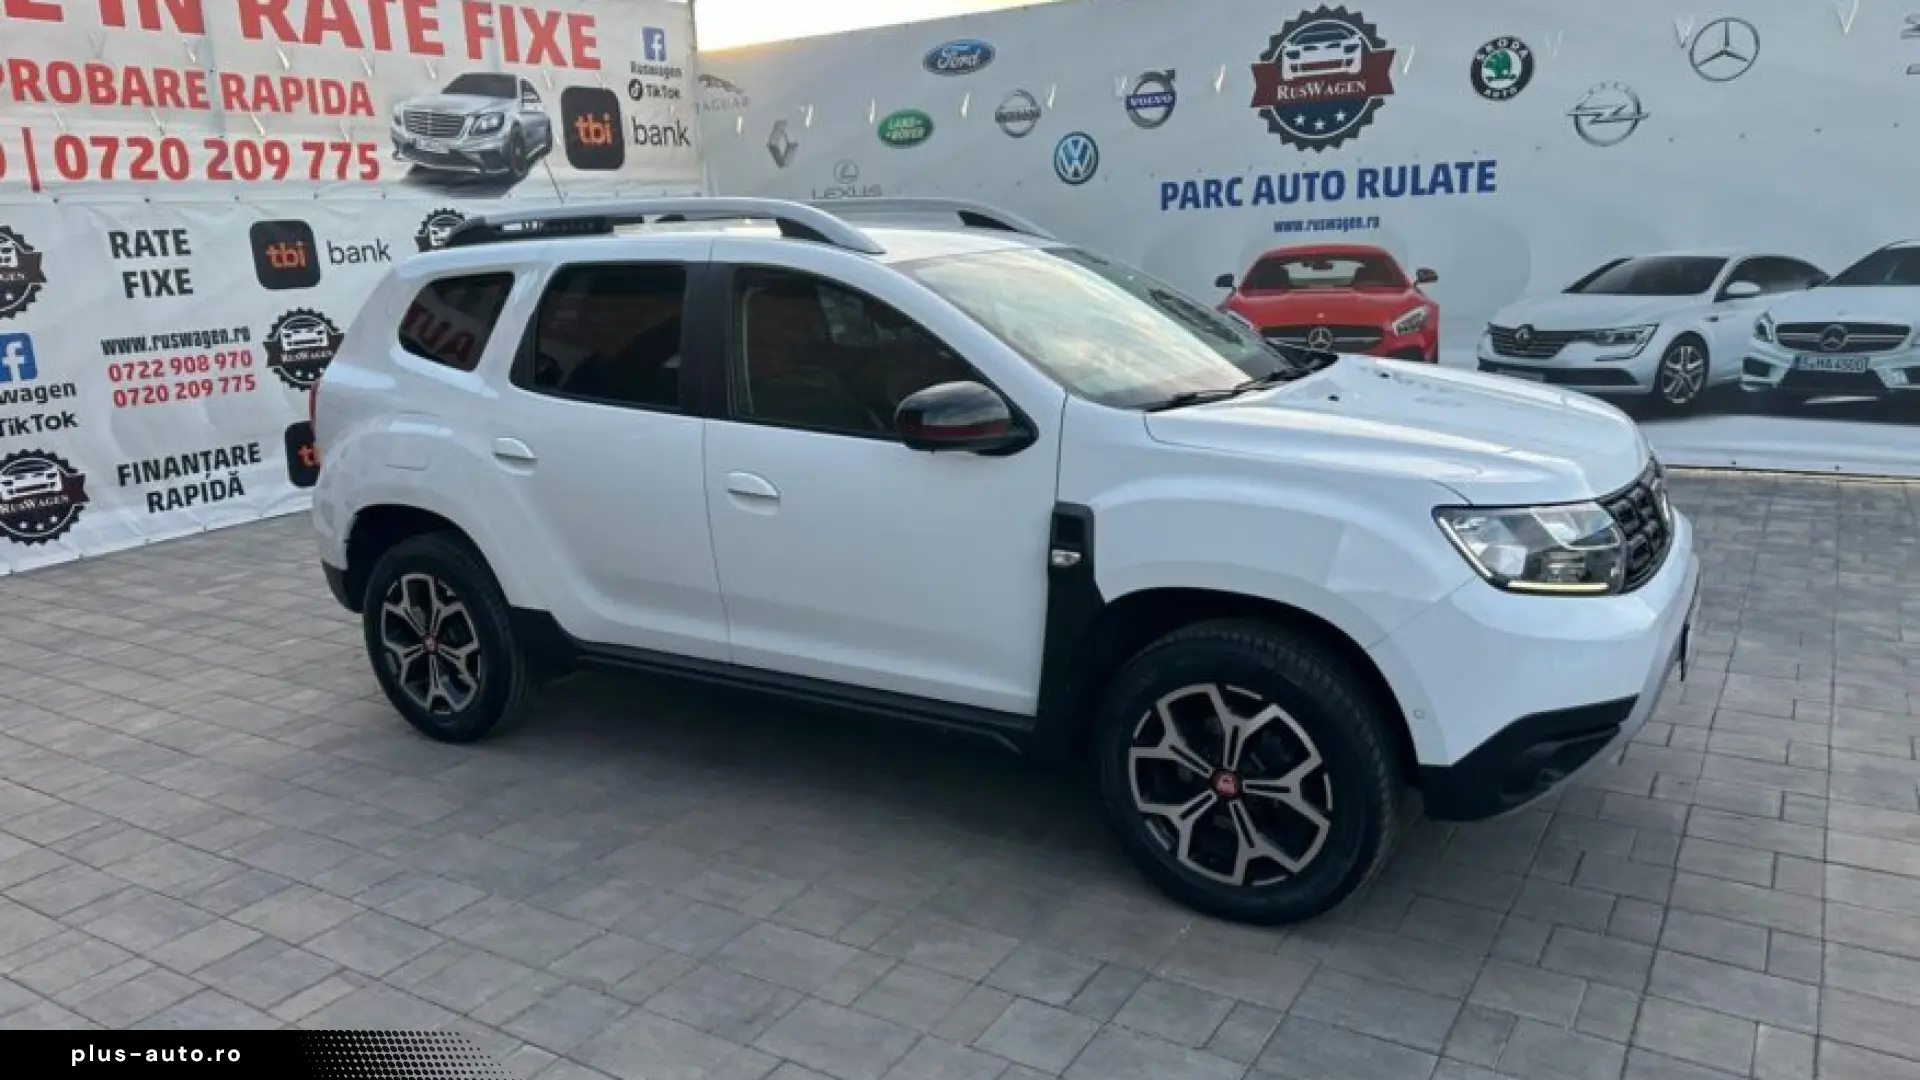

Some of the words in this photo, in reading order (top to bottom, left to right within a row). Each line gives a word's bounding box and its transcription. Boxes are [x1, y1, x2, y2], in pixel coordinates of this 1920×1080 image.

[237, 0, 446, 56] RATE
[463, 3, 601, 69] FIXE
[0, 58, 211, 110] ROBARE
[218, 72, 375, 116] RAPIDA
[575, 113, 615, 145] tbi
[631, 116, 692, 148] bank
[54, 134, 190, 181] 0720
[203, 138, 290, 181] 209
[302, 142, 380, 181] 775
[1160, 177, 1244, 211] PARC
[1252, 170, 1346, 206] AUTO
[1356, 159, 1498, 199] RULATE
[107, 228, 192, 259] RATE
[264, 242, 310, 269] tbi
[326, 239, 393, 265] bank
[122, 268, 194, 299] FIXE
[101, 325, 251, 356] www.ruswagen.ro
[108, 361, 165, 383] 0722
[169, 354, 210, 376] 908
[214, 350, 253, 370] 970
[112, 384, 169, 408] 0720
[174, 378, 214, 402] 209
[218, 374, 257, 394] 775
[146, 470, 245, 514] RAPIDĂ
